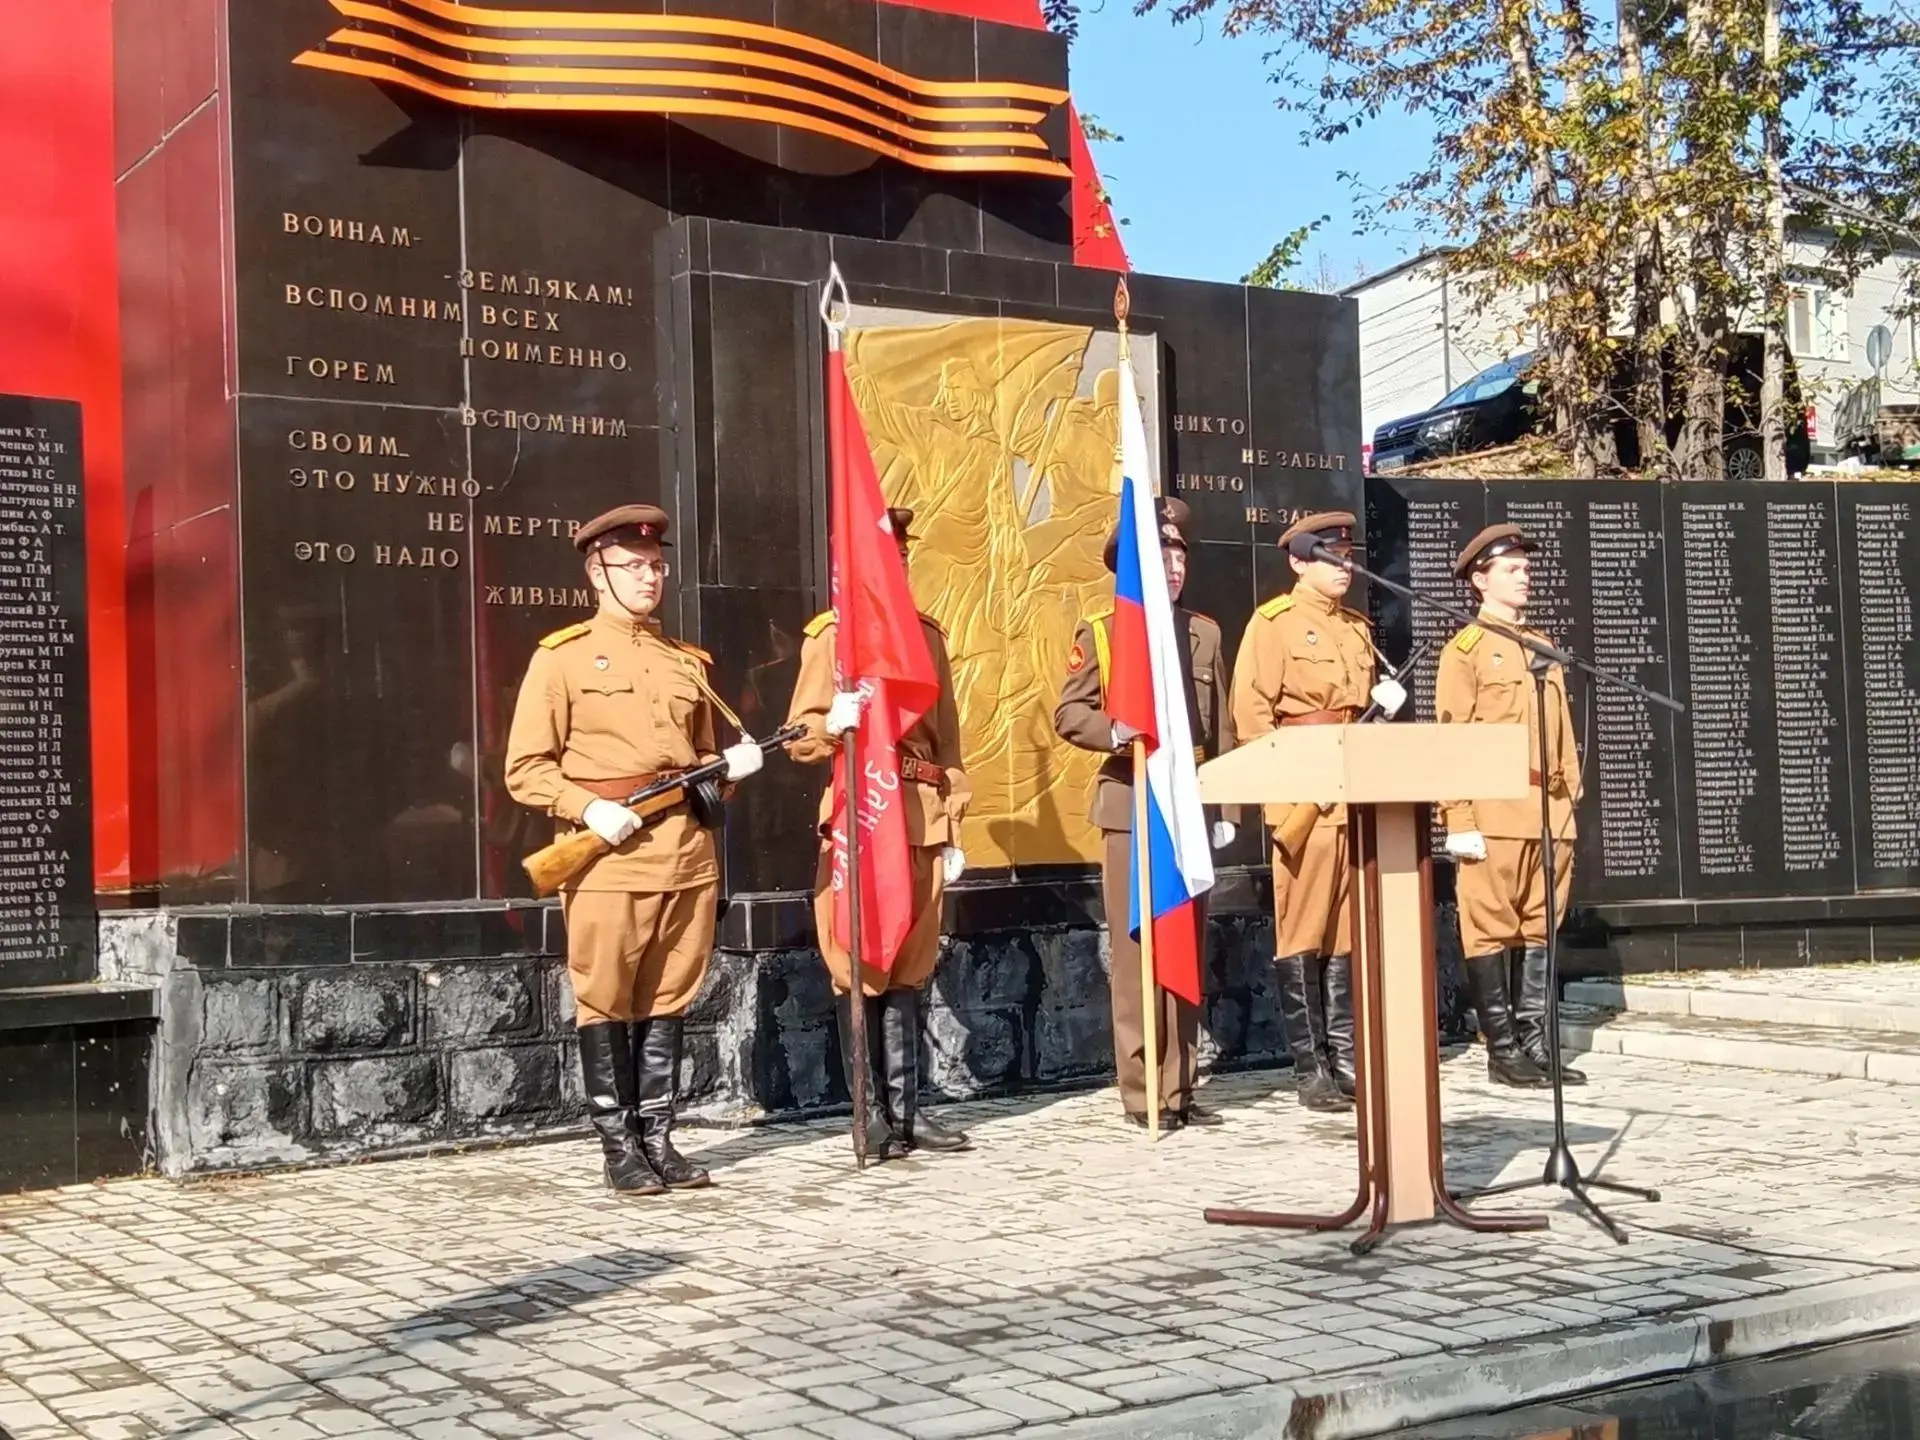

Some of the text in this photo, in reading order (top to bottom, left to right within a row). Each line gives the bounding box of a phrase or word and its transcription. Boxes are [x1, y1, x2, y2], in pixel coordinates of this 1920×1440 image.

[286, 285, 561, 331] ВСПОМНИМ ВСЕХ
[287, 357, 397, 384] ГОРЕМ
[461, 408, 629, 438] ВСПОМНИМ
[1173, 415, 1245, 436] НИКТО
[1242, 449, 1269, 466] НЕ
[290, 468, 355, 491] ЭТО
[1176, 474, 1244, 493] НИЧТО
[428, 512, 465, 533] НЕ
[1246, 507, 1269, 524] НЕ
[295, 541, 461, 569] ЭТО НАДО
